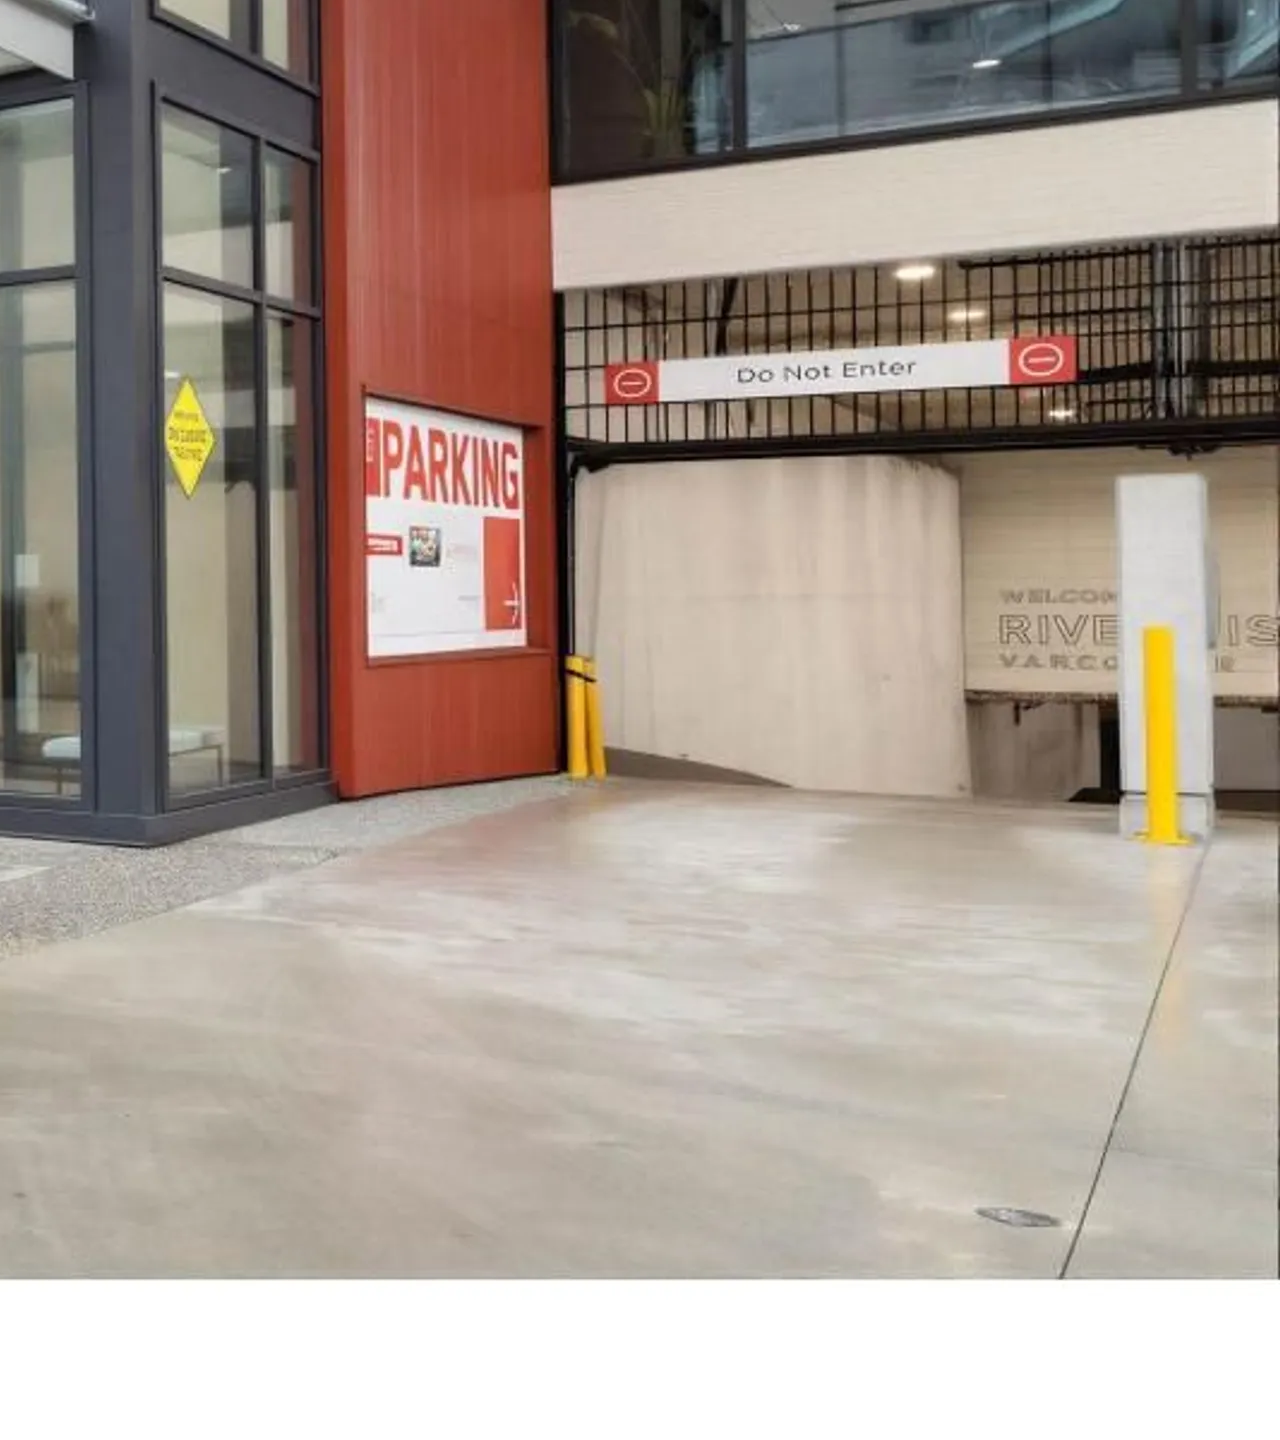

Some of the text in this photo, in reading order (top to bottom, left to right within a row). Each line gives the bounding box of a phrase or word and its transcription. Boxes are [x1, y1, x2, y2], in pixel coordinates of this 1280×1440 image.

[737, 360, 917, 384] Do Not Enter
[382, 418, 520, 510] PARKING
[998, 587, 1118, 604] WELCOM
[999, 614, 1120, 646] RIVE
